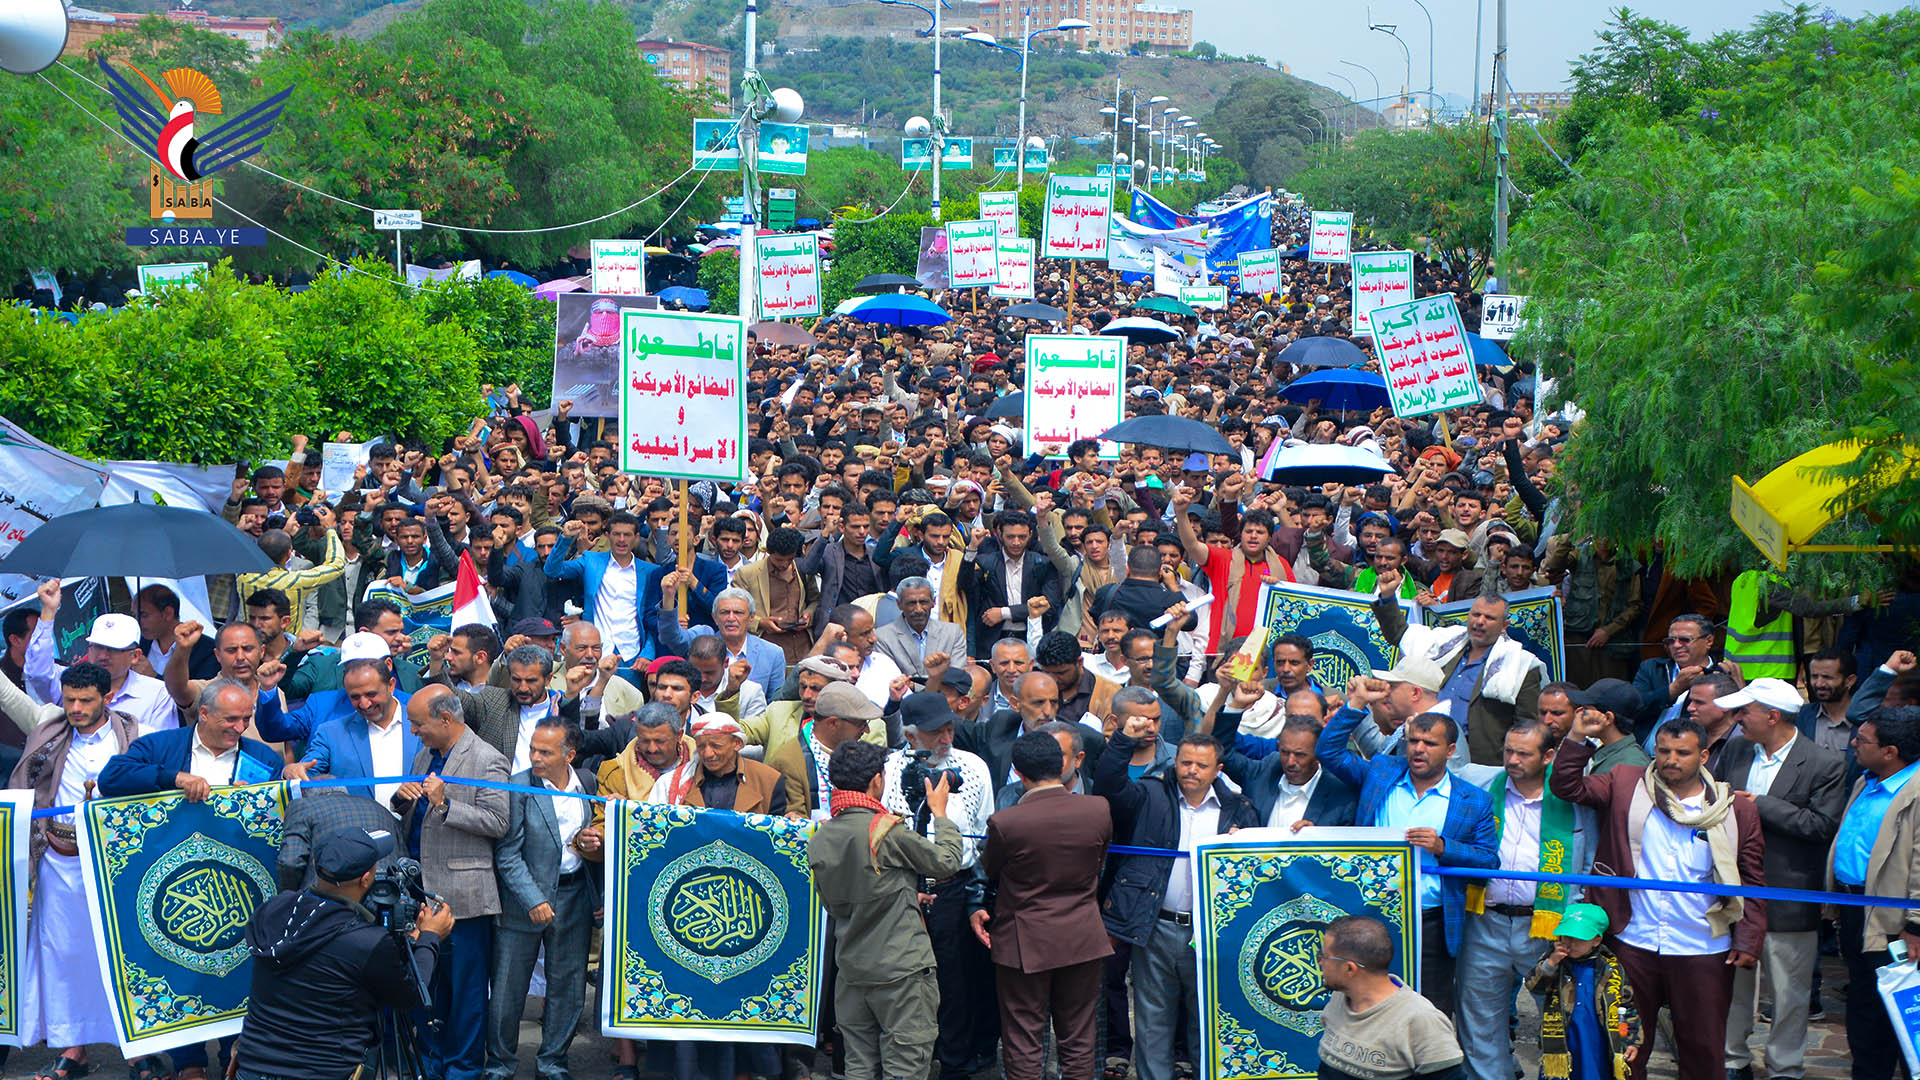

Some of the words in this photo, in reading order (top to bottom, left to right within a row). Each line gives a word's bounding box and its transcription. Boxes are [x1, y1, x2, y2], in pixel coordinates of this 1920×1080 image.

[1053, 181, 1108, 198] قاطعوا
[1052, 203, 1080, 217] الأمريكية
[1081, 205, 1107, 219] البضائع
[952, 226, 993, 241] قاطعوا
[1075, 221, 1079, 232] و
[760, 240, 813, 260] قاطعوا
[1050, 236, 1105, 252] الإسرائيلية
[761, 262, 789, 278] الأمريكية
[790, 264, 814, 277] البضائع
[1357, 259, 1408, 276] قاطعوا
[786, 280, 790, 291] و
[1384, 280, 1408, 293] البضائع
[764, 295, 816, 310] الإسرائيلية
[1183, 292, 1222, 304] قاطعوا
[1379, 304, 1419, 336] أكبر
[1425, 302, 1453, 321] الله
[1382, 330, 1422, 351] لأمريكا
[1425, 324, 1459, 343] الموت
[631, 327, 734, 361] قاطعوا
[1430, 343, 1464, 362] الموت
[1035, 348, 1116, 372] قاطعوا
[1388, 351, 1428, 372] لإسرائيل
[1424, 369, 1440, 385] على
[1443, 362, 1469, 377] اللعنة
[631, 369, 686, 398] الأمريكية
[687, 375, 735, 401] البضائع
[1034, 379, 1076, 398] الأمريكية
[1392, 372, 1420, 390] اليهود
[1078, 382, 1115, 399] البضائع
[1441, 379, 1475, 404] النصر
[1398, 387, 1436, 413] للإسلام
[676, 405, 685, 425] و
[1070, 404, 1075, 419] و
[631, 433, 736, 466] الإسرائيلية
